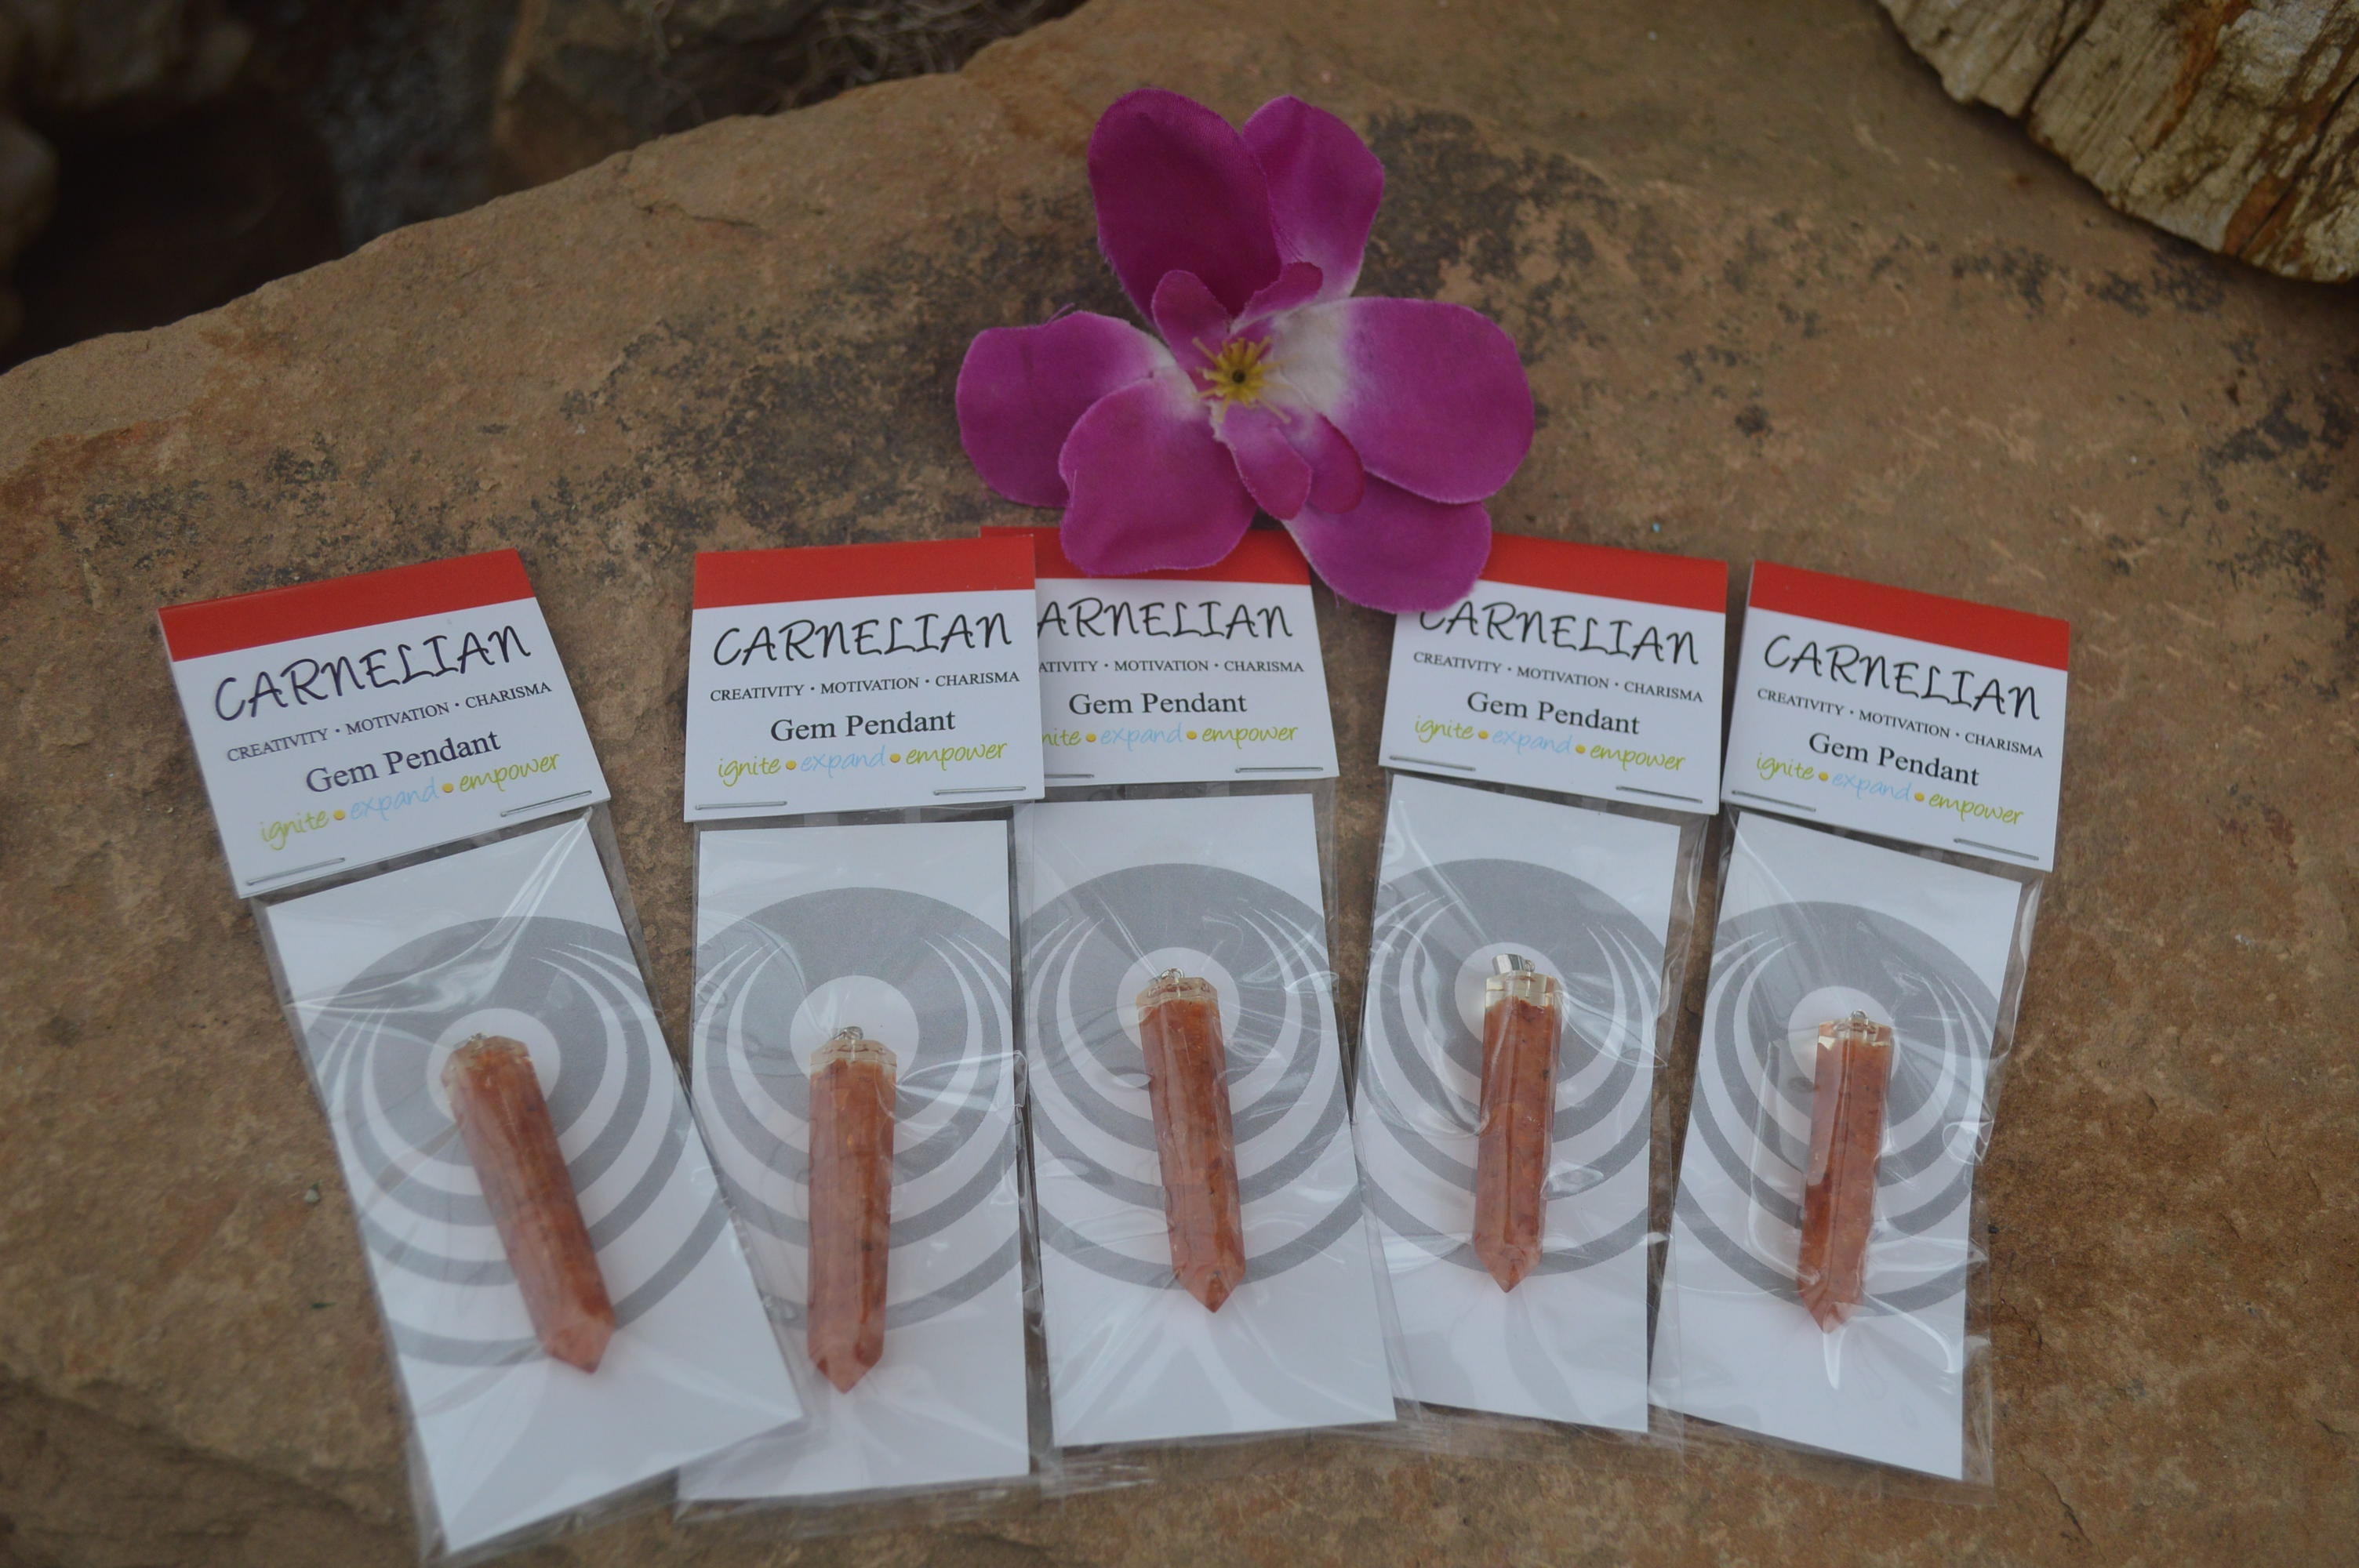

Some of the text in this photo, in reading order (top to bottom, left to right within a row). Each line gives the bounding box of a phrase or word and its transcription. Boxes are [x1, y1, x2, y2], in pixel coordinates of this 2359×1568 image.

[713, 612, 1012, 666] CARNELIAN
[1037, 597, 1293, 639] ARNELIAN
[215, 626, 532, 721] CARNELIAN
[710, 671, 1020, 702] CREATIVITY MOTIVATION CHARISMA
[1039, 660, 1304, 673] ATIVITY MOTIVATION CHARISMA
[1413, 651, 1703, 702] CREATIVITY MOTIVATION CHARISMA
[1764, 635, 2040, 720] CARNELIAN
[227, 681, 552, 762] CREATIVITY MOTIVATION CHARISMA
[770, 710, 956, 742] Gem Pendant
[1068, 692, 1248, 714] Gem Pendant
[1467, 691, 1640, 735] Gem Pendant
[1757, 688, 2044, 758] CREATIVITY MOTIVATION CHARISMA
[306, 731, 502, 793] Gem Pendant
[1041, 722, 1298, 751] nite expand empower
[1414, 715, 1686, 771] ignite expand empower
[1809, 732, 1979, 786] Gem Pendant
[718, 742, 1008, 786] ignite expand empower
[1757, 753, 2024, 825] ignite expand empower
[261, 753, 561, 850] ignite expand empower
